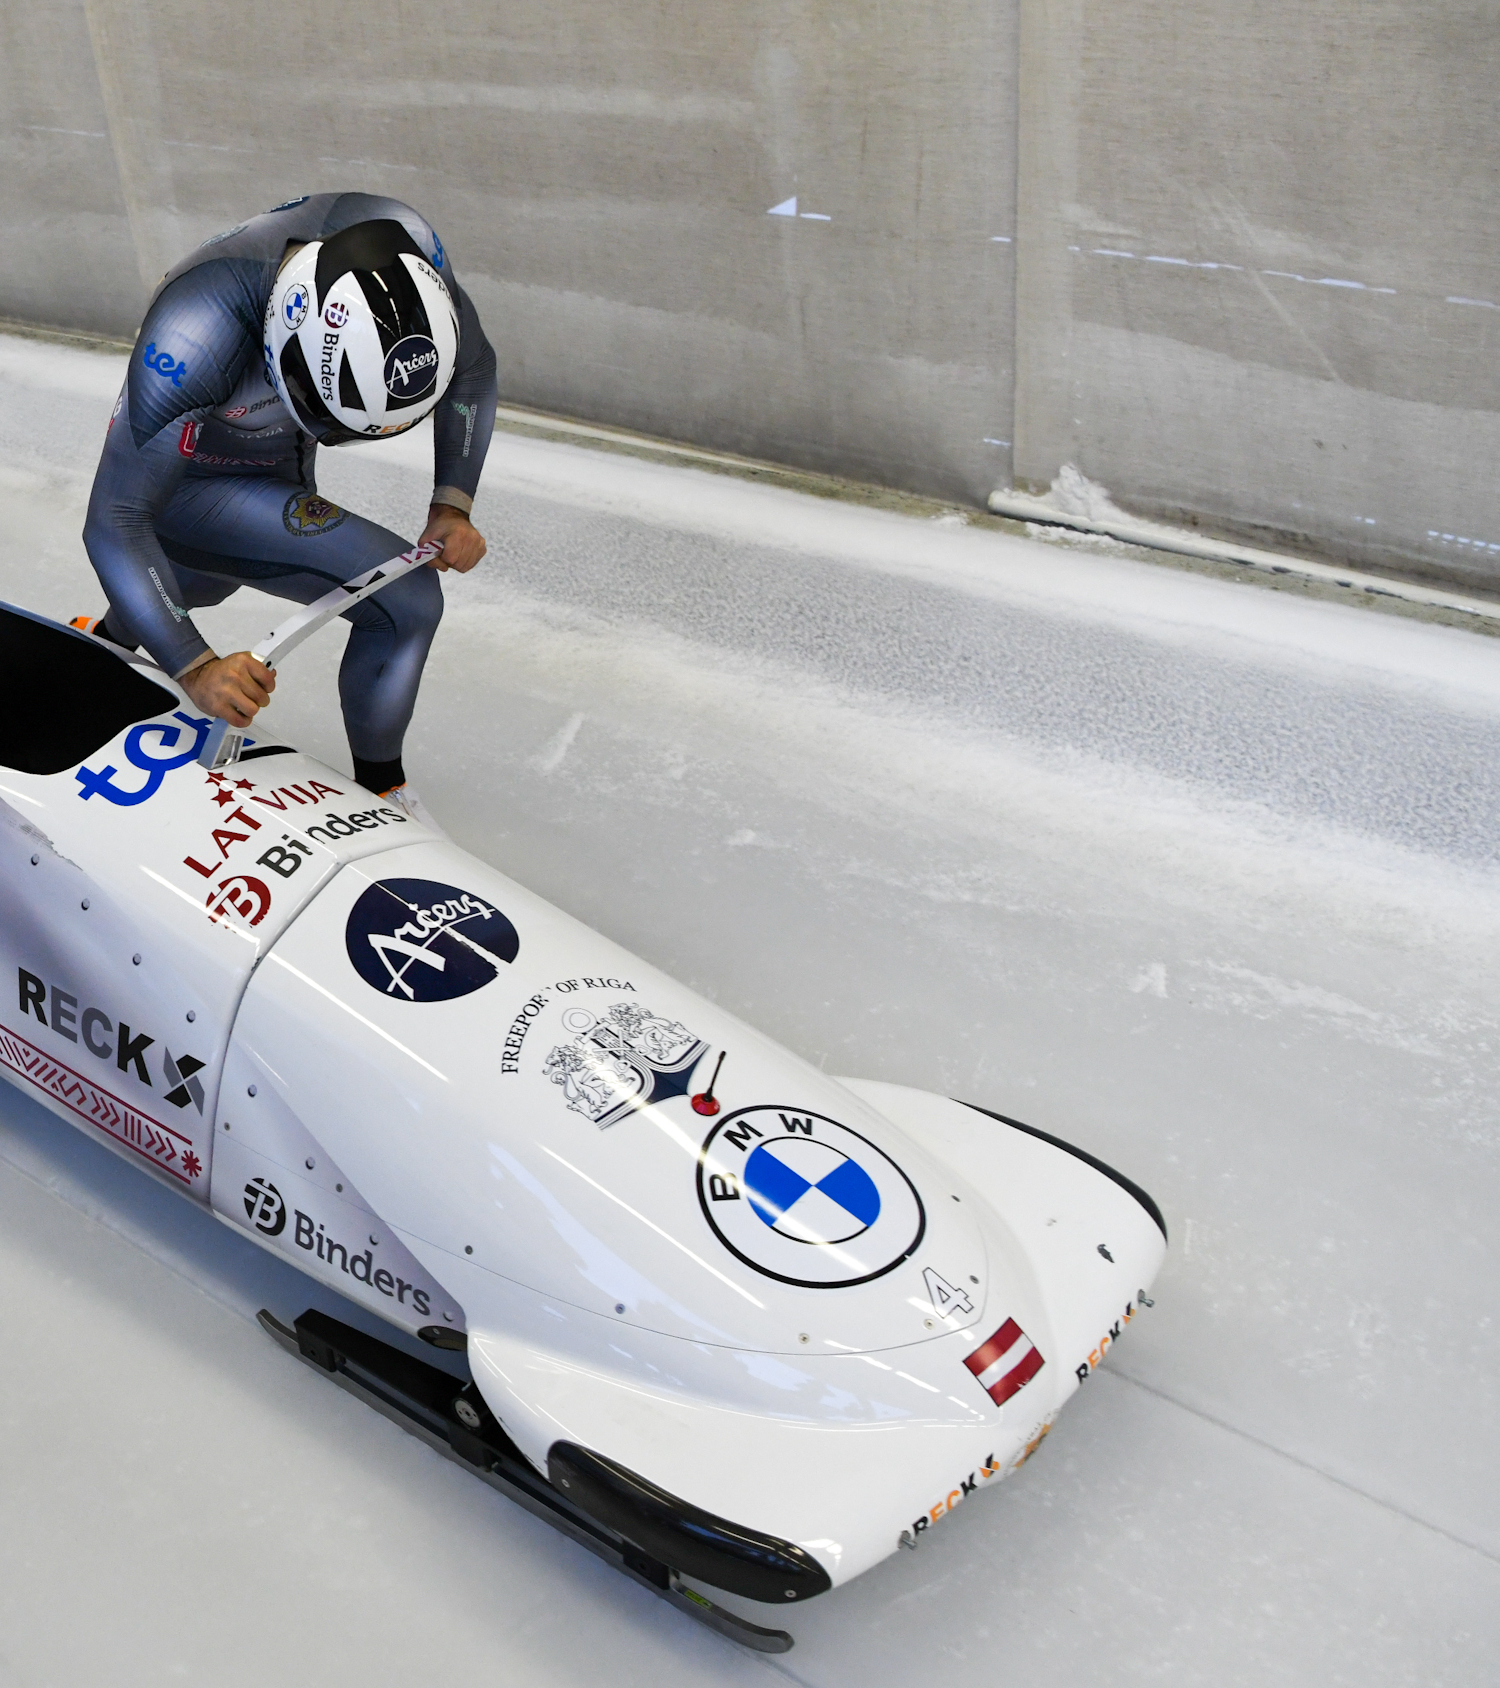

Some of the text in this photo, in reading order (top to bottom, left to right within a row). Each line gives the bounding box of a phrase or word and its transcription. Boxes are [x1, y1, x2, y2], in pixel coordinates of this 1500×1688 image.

[143, 343, 187, 388] tet
[321, 333, 340, 401] Binders
[183, 780, 345, 879] LATVIJA
[255, 807, 408, 879] Binders
[501, 977, 638, 1075] FREEPOR OF RIGA
[709, 1112, 814, 1202] BMW
[294, 1209, 431, 1316] Binders
[922, 1266, 974, 1319] 4
